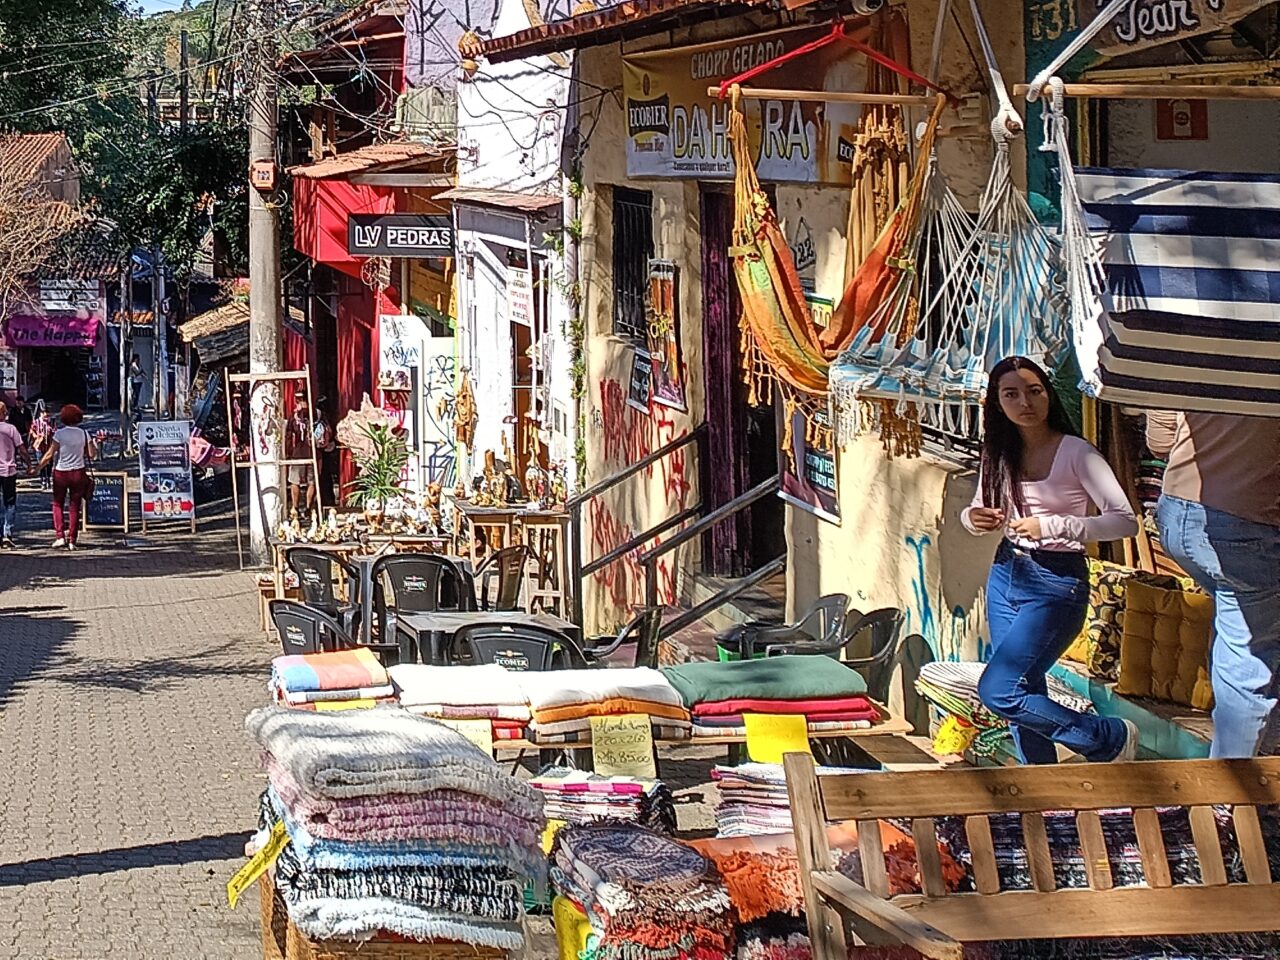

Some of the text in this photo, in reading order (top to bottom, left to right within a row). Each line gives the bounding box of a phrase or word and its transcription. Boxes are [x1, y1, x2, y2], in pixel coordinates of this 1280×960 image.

[691, 39, 785, 80] CHOPP GELADO
[629, 105, 669, 128] ECOBIER
[672, 103, 704, 159] DA
[355, 225, 451, 247] LV PEDRAS
